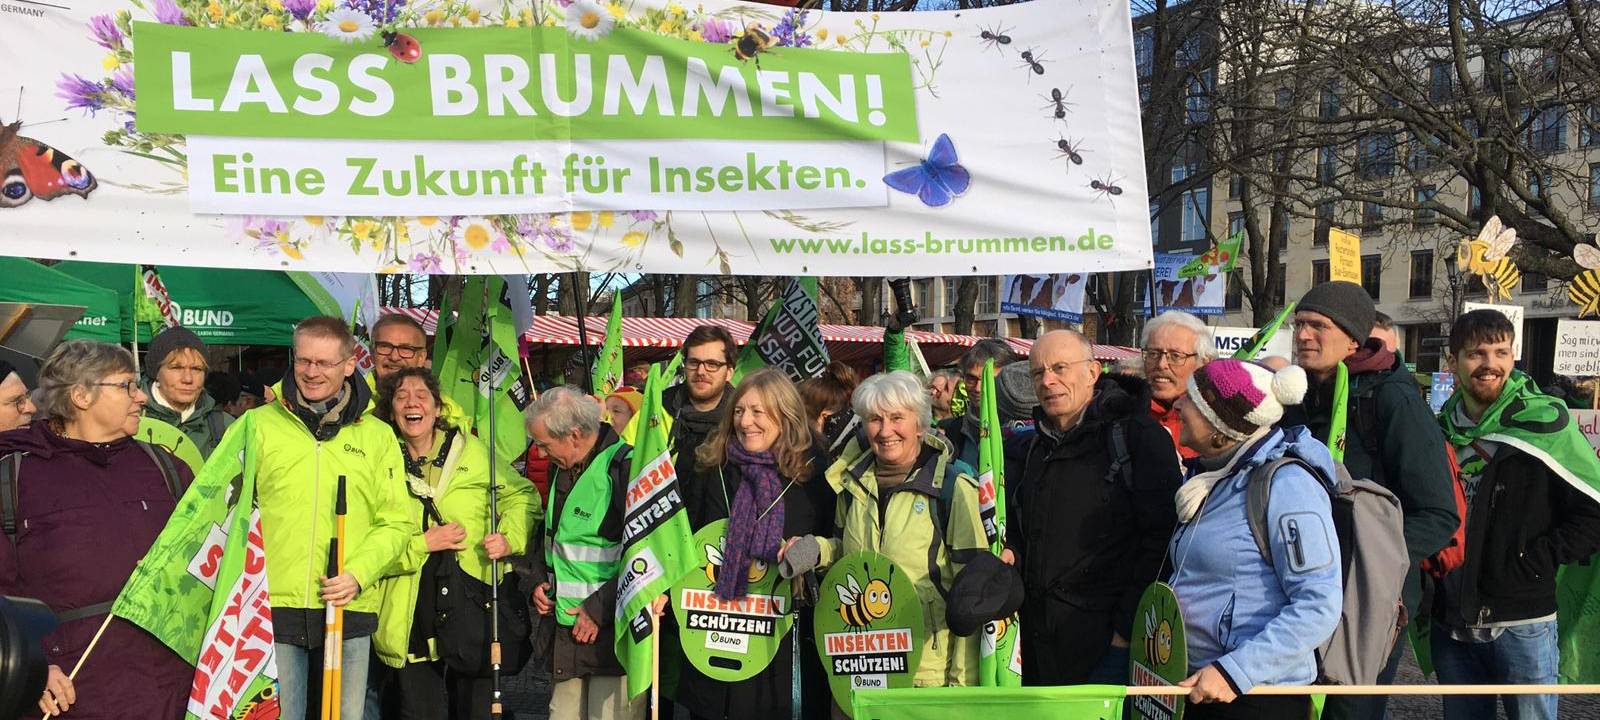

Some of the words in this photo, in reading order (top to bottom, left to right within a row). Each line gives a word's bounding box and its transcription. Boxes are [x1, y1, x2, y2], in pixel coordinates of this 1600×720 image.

[1, 3, 45, 17] GERMANY
[171, 50, 395, 116] LASS
[427, 52, 887, 127] BRUMMEN!
[212, 152, 325, 194] Eine
[345, 153, 547, 197] Zukunft
[562, 152, 631, 195] für
[648, 151, 867, 193] Insekten.
[769, 227, 1115, 256] www.lass-brummen.de
[182, 308, 234, 327] BUND
[1560, 333, 1577, 348] Sag
[689, 613, 772, 635] SCHÜTZEN!
[719, 636, 742, 647] BUND
[827, 631, 909, 654] INSEKTEN
[834, 655, 905, 673] SCHÜTZEN!
[861, 678, 882, 687] BUND
